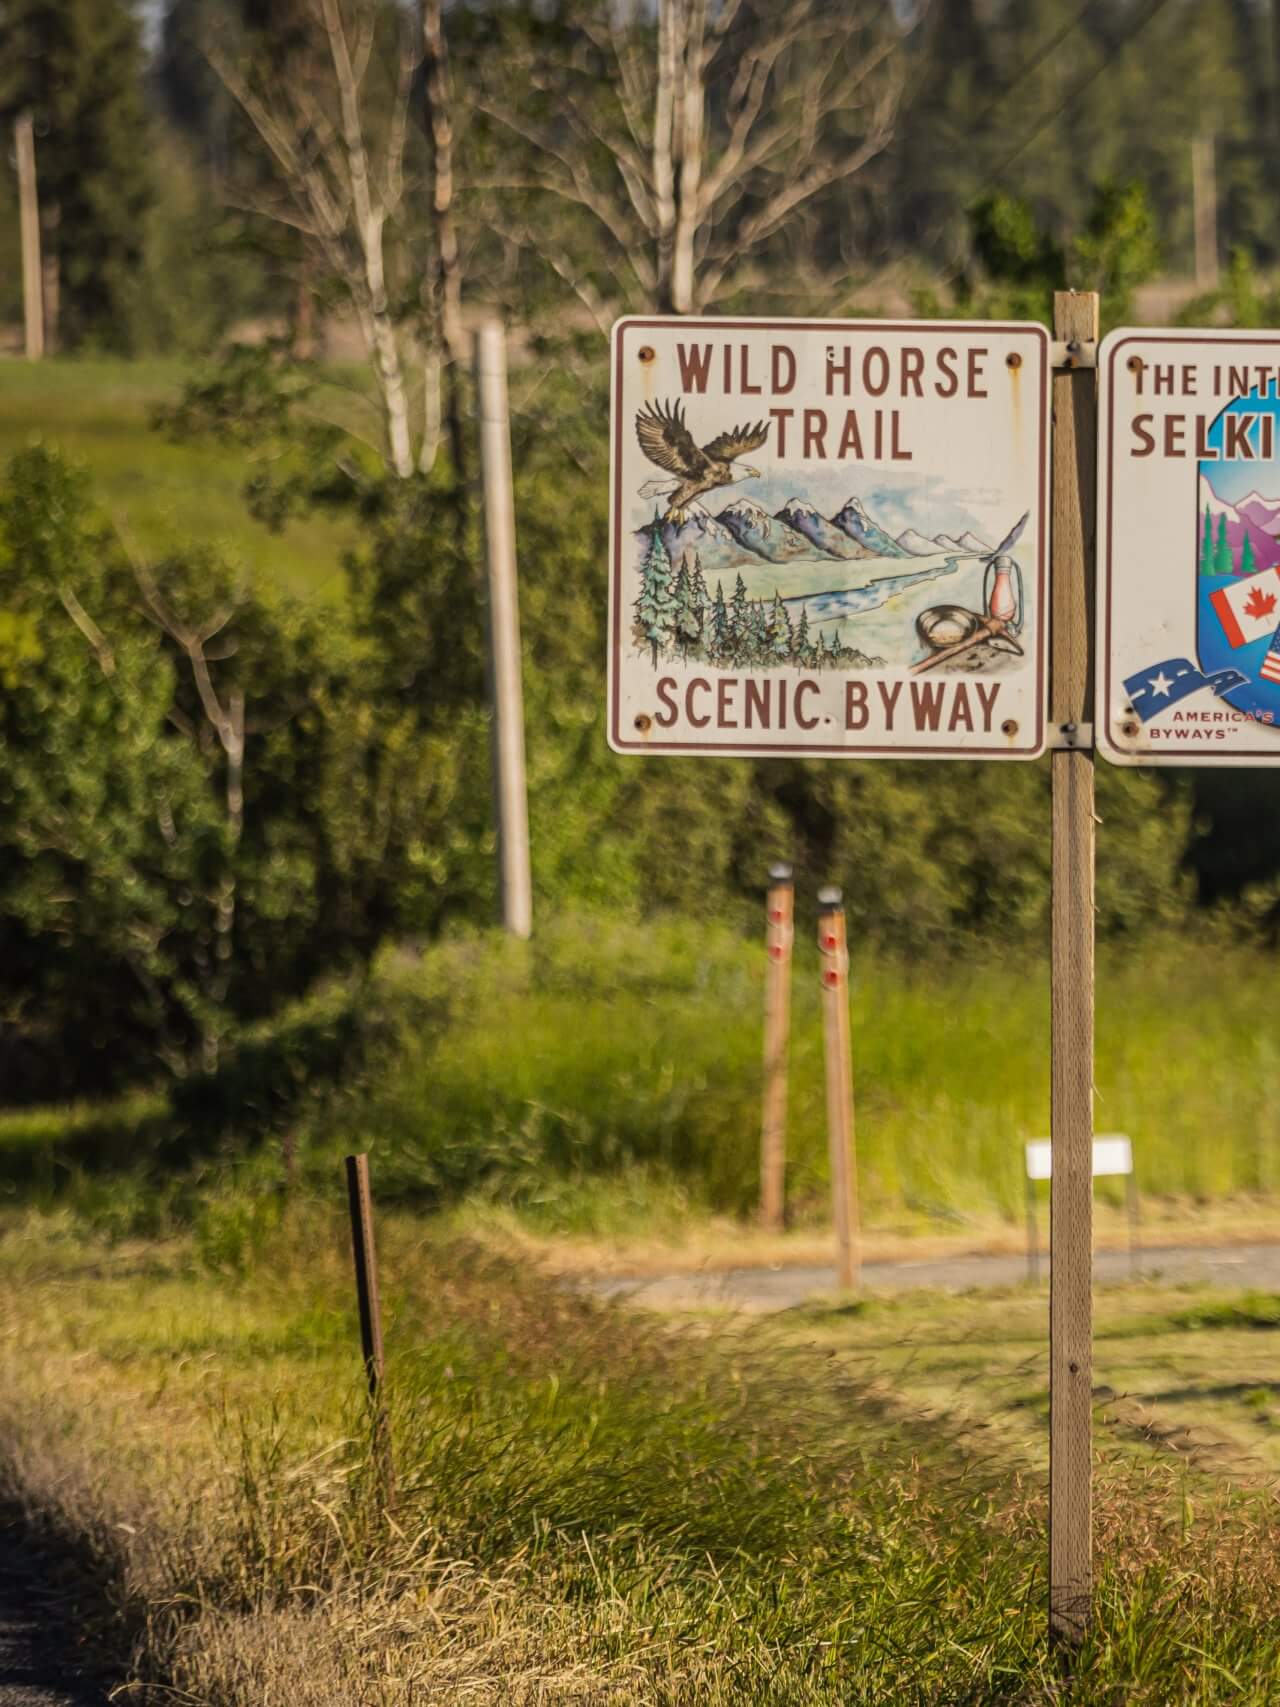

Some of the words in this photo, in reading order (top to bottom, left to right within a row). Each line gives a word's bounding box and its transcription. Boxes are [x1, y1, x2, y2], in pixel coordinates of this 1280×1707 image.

[676, 343, 797, 395] WILD
[825, 345, 989, 398] HORSE
[1132, 364, 1197, 396] THE
[769, 408, 913, 460] TRAIL
[654, 677, 820, 729] SCENIC
[845, 680, 1001, 732] BYWAY
[1173, 711, 1274, 723] AMERICA'S
